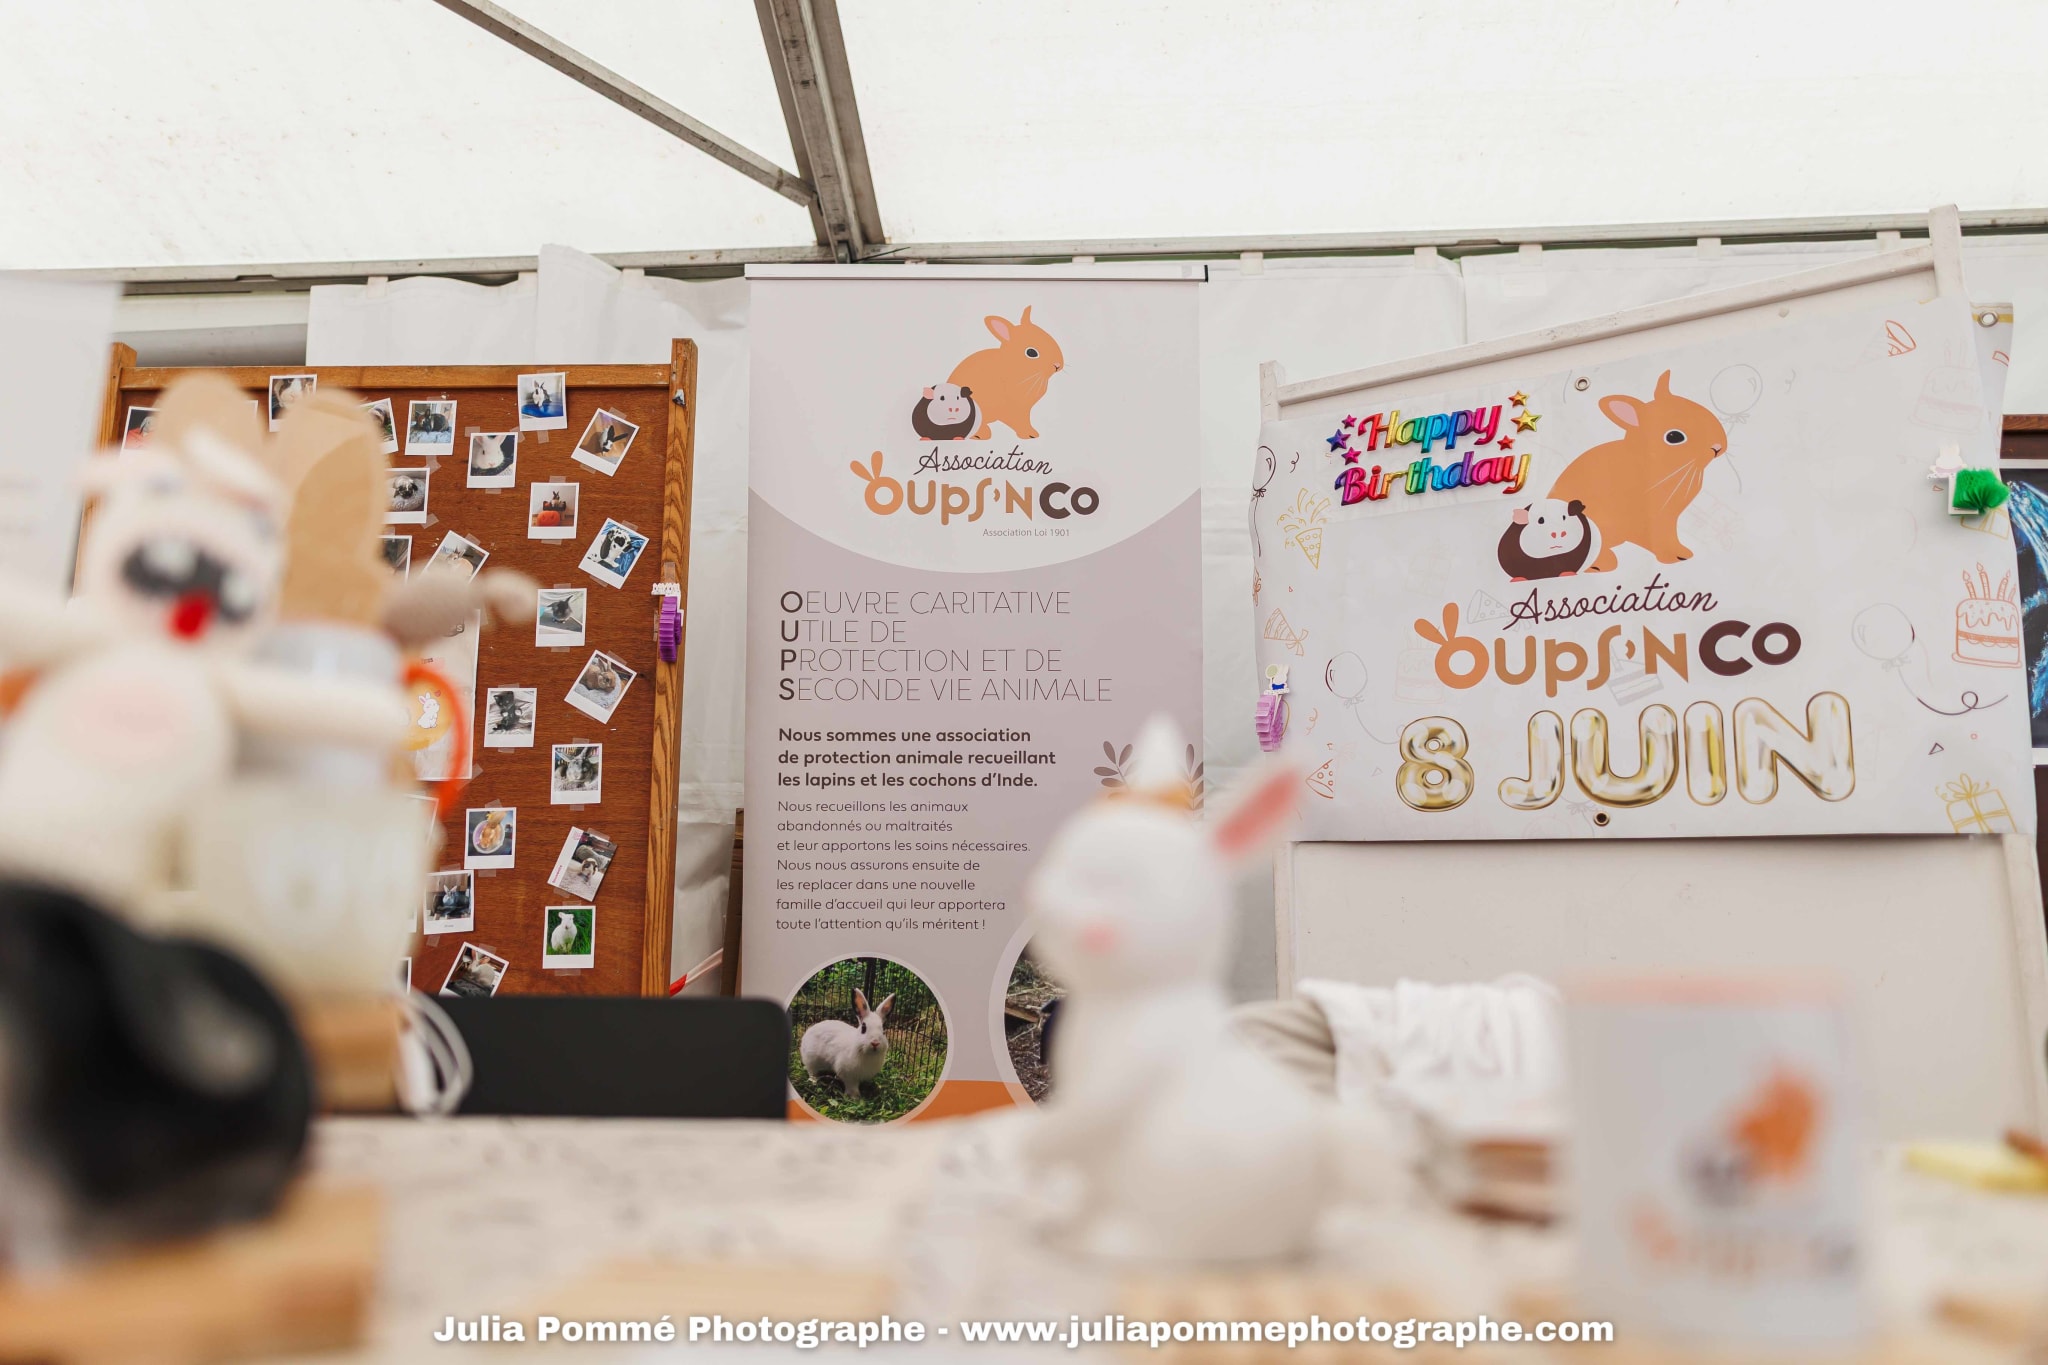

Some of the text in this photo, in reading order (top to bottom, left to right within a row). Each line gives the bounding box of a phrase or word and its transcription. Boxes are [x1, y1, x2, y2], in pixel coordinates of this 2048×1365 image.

[1358, 403, 1502, 454] Happy
[913, 445, 1052, 475] Association
[1334, 450, 1532, 506] Birthday
[781, 591, 1070, 614] OEUVRE CARITATIVE
[1502, 572, 1718, 631] Association
[781, 620, 906, 642] UTILE DE
[781, 649, 1061, 672] PROTECTION ET DE
[779, 678, 1112, 701] SECONDE VIE ANIMALE
[779, 728, 1030, 741] Nous sommes une association
[778, 750, 1056, 767] de protection animale recueillant
[1396, 691, 1856, 813] 8 JUIN
[779, 772, 800, 786] les
[806, 773, 855, 789] lapins
[861, 774, 877, 786] et
[883, 773, 904, 786] les
[909, 773, 976, 786] cochons
[778, 801, 968, 811] Nous recueillons les animaux
[778, 820, 952, 831] abandonnés ou maltraités
[777, 840, 1030, 853] et leur apportons les soins nécessaires.
[778, 860, 980, 870] Nous nous assurons ensuite de
[777, 879, 794, 890] les
[798, 879, 853, 892] replacer
[856, 879, 888, 889] dans
[921, 880, 975, 890] nouvelle
[776, 899, 821, 909] famille
[887, 899, 906, 912] qui
[911, 899, 935, 909] leur
[939, 900, 1005, 912] apportera
[776, 920, 811, 929] toute
[923, 919, 979, 929] méritent
